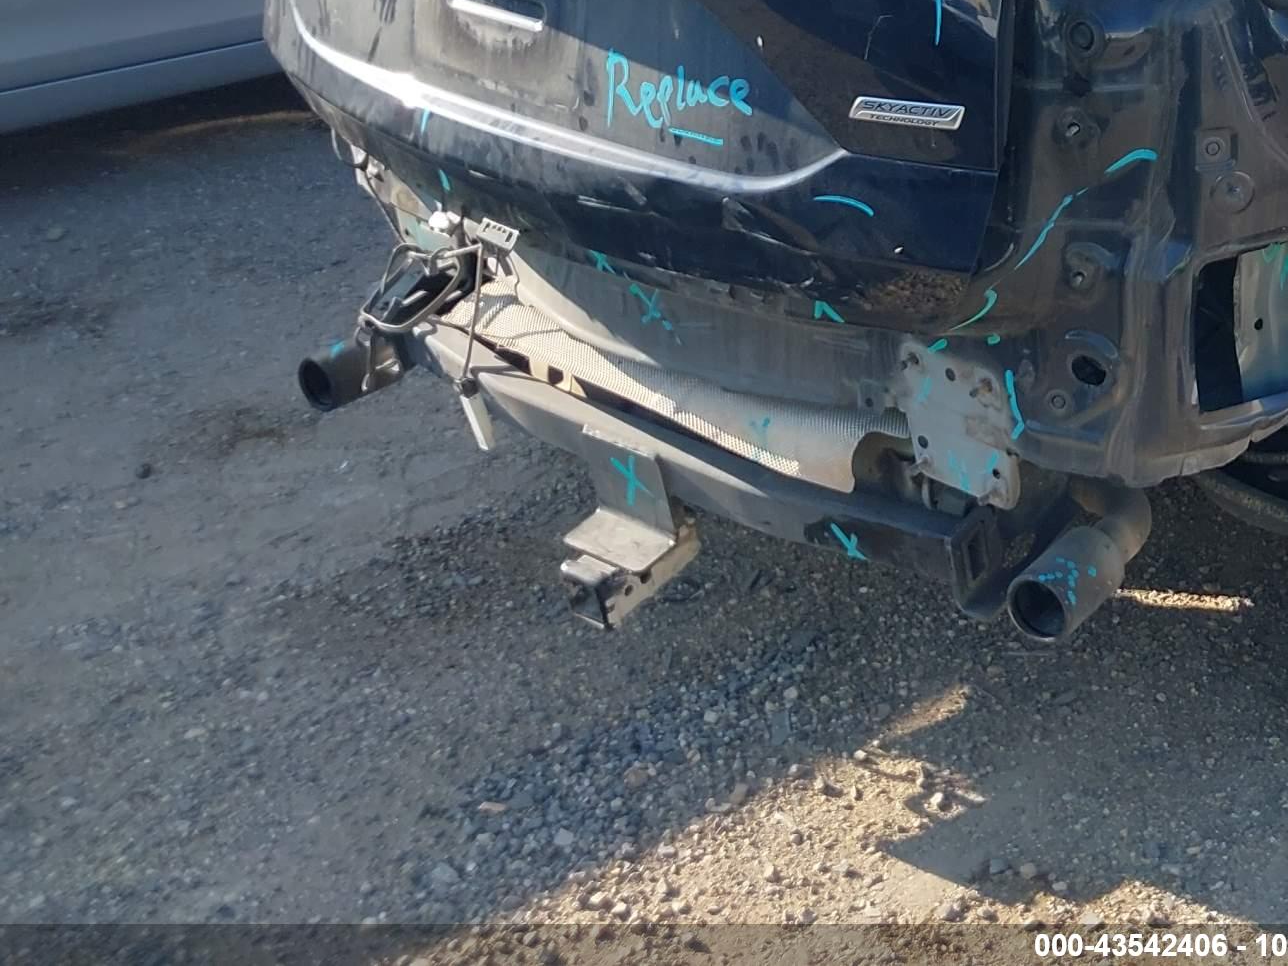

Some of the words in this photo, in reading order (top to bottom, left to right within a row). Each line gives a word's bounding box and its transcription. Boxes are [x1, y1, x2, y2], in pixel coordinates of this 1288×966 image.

[607, 48, 752, 128] Replace
[863, 100, 952, 117] SKYACTIV
[869, 114, 940, 126] TECHNOLOGY
